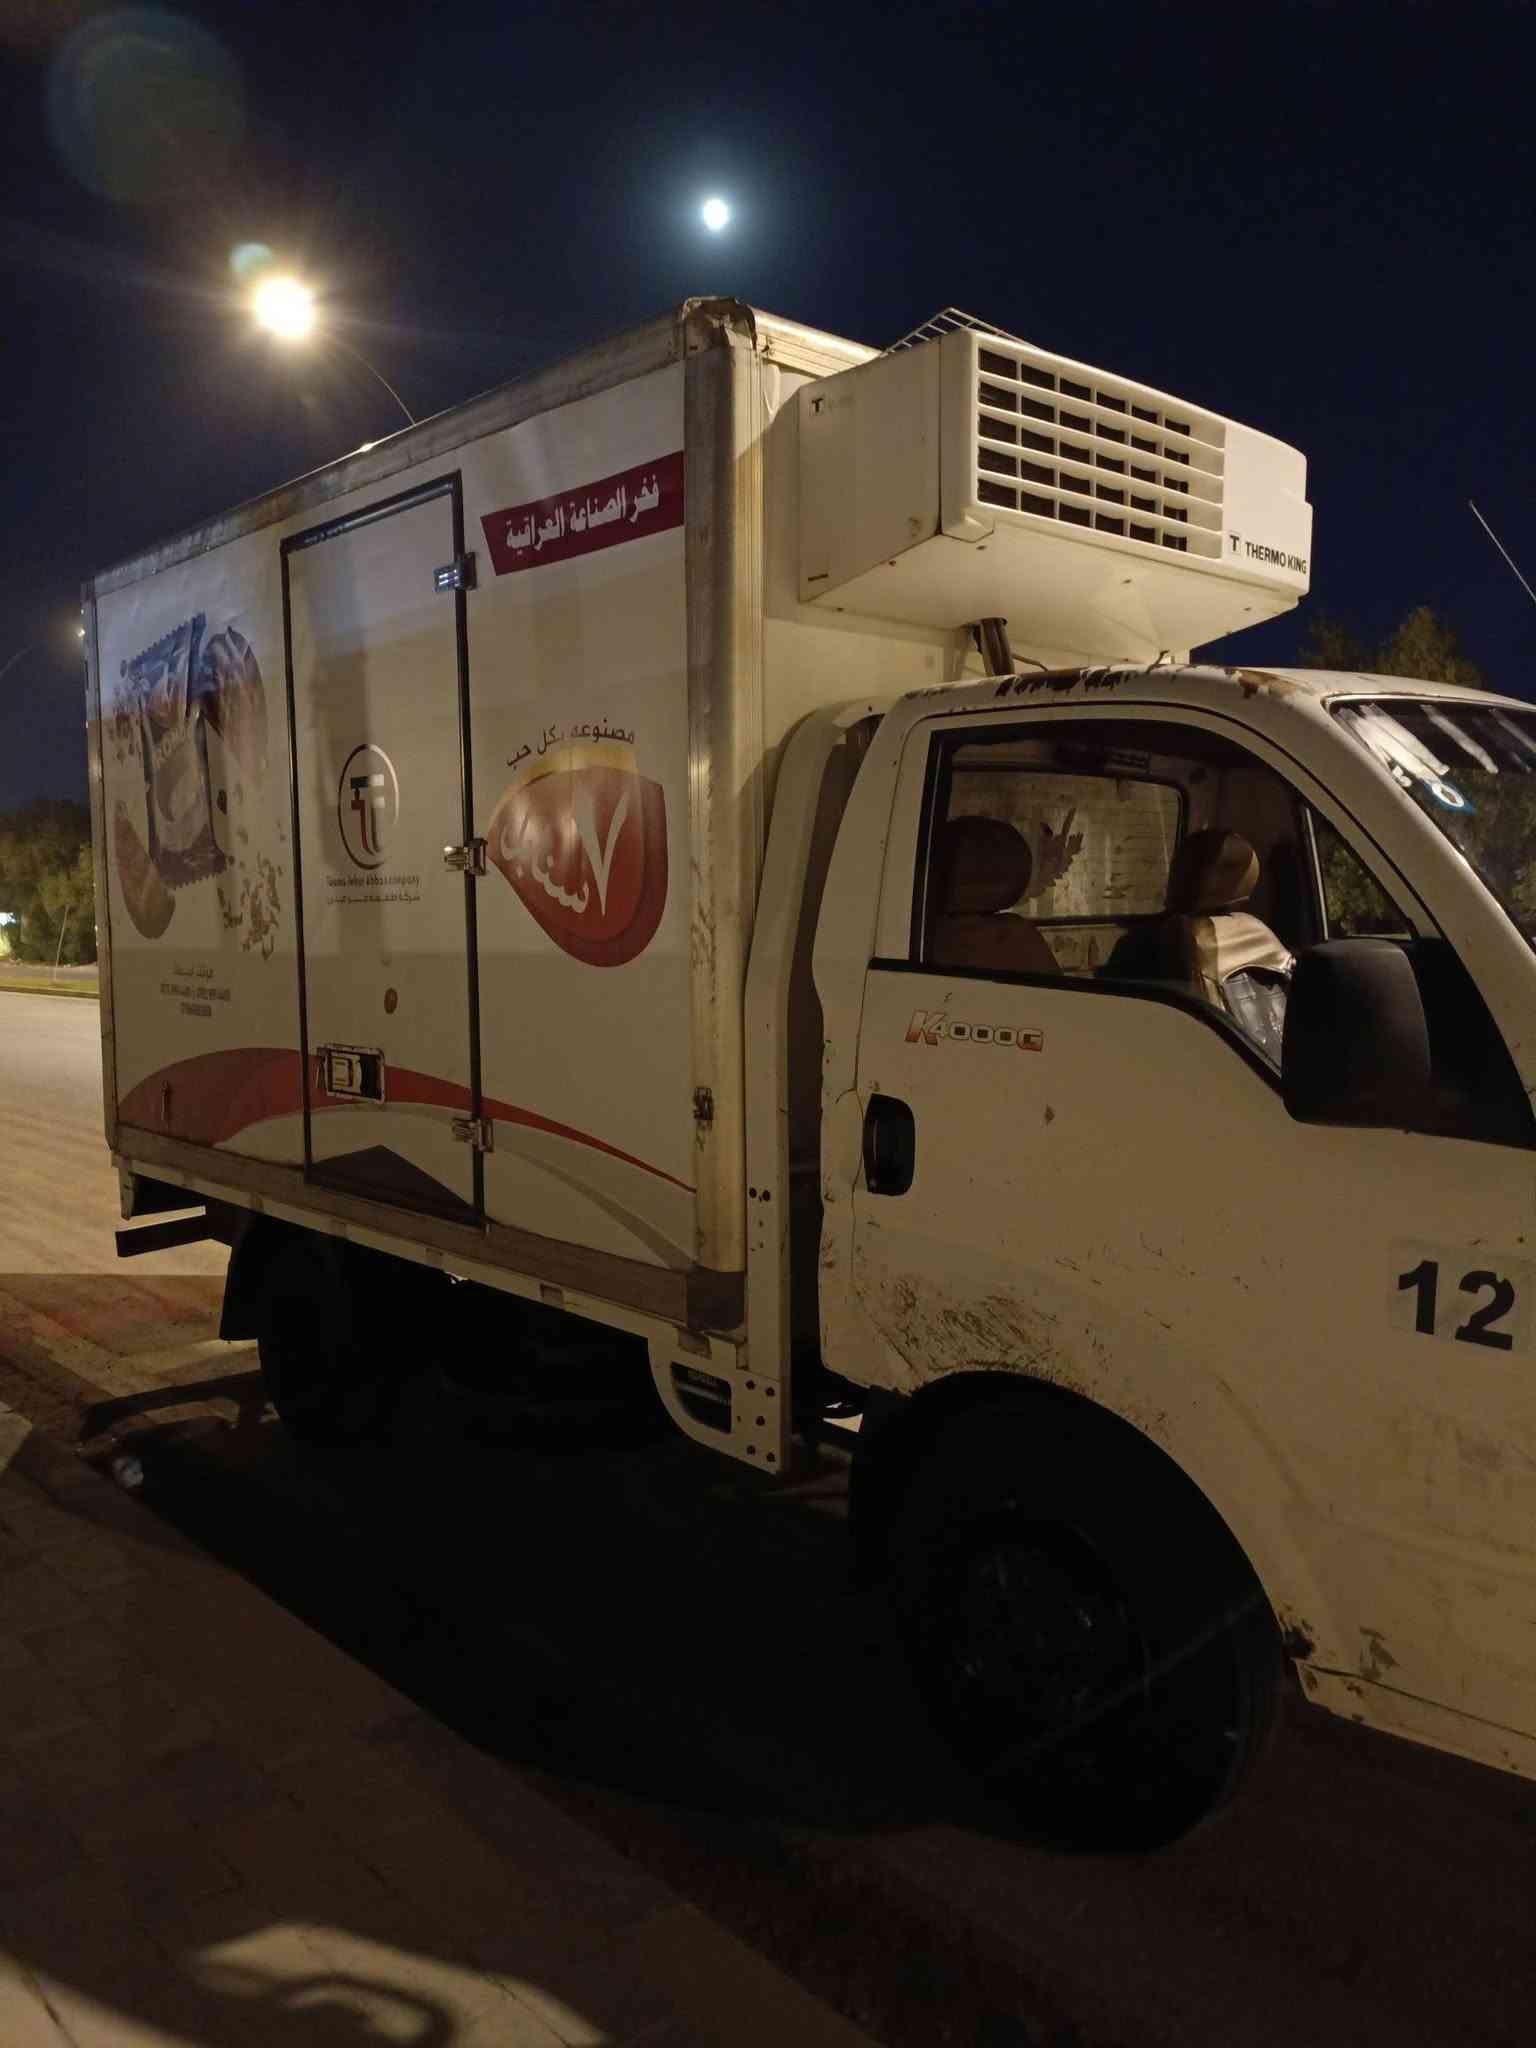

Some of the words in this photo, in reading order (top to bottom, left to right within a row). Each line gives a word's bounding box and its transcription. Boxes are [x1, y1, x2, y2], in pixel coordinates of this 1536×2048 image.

[570, 483, 628, 533] الصناعة
[630, 473, 659, 524] فخر
[505, 505, 565, 557] العراقية
[1246, 541, 1287, 567] THERMO
[1287, 553, 1307, 575] KING
[506, 744, 532, 772] حب
[904, 1008, 1044, 1052] K4000G
[1398, 1260, 1516, 1351] 12
